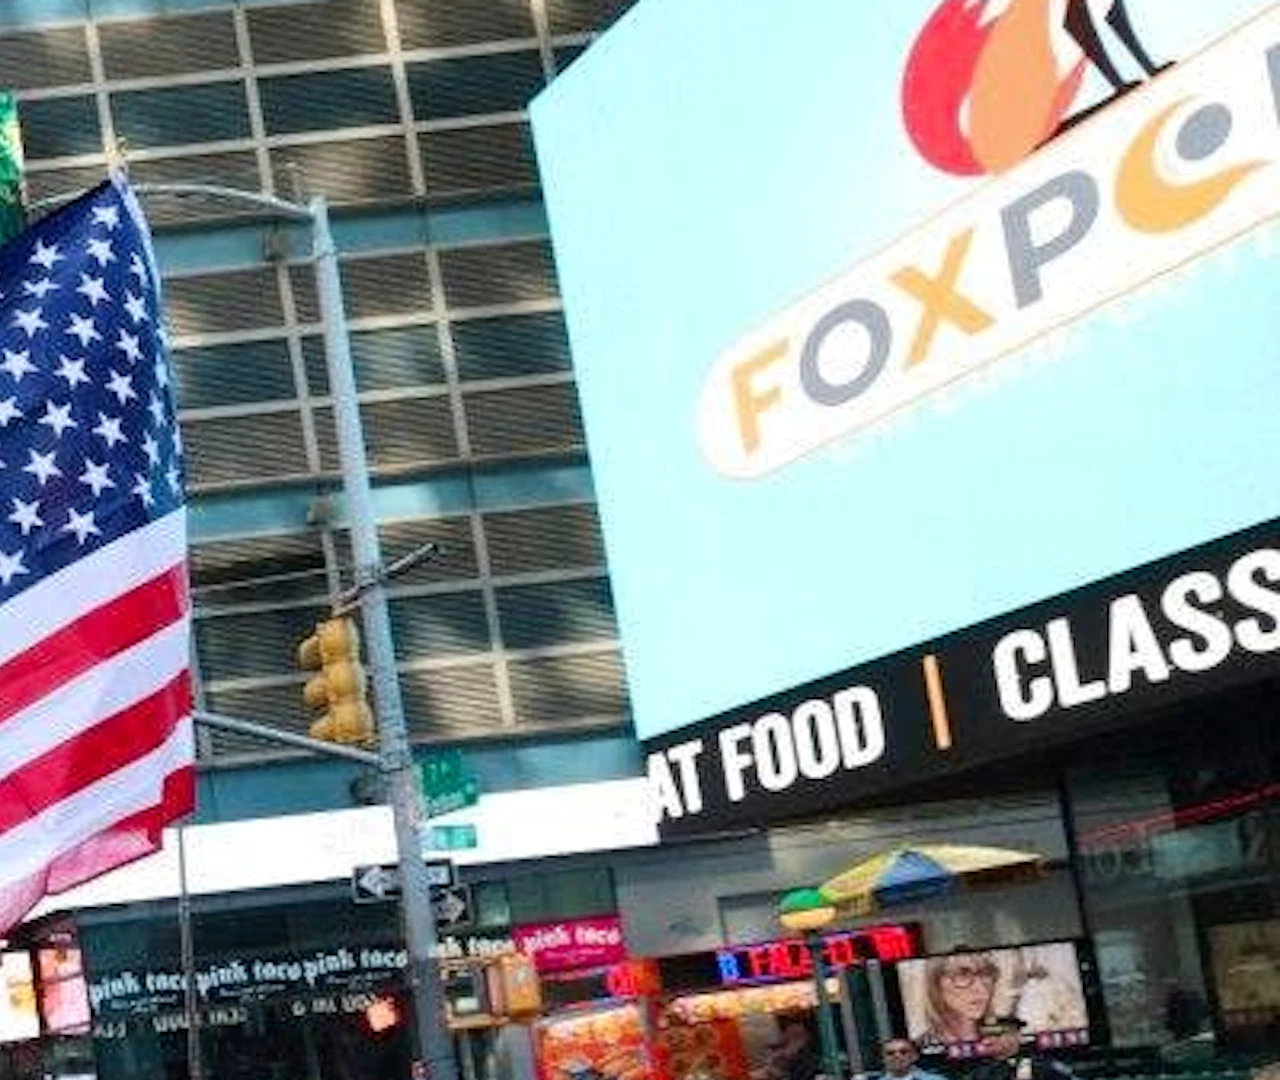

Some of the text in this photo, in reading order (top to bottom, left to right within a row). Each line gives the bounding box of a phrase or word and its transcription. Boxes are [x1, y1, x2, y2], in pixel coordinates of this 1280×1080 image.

[718, 684, 886, 804] FOOD
[993, 547, 1280, 723] CLASS
[303, 948, 357, 987] pink
[360, 949, 409, 970] taco
